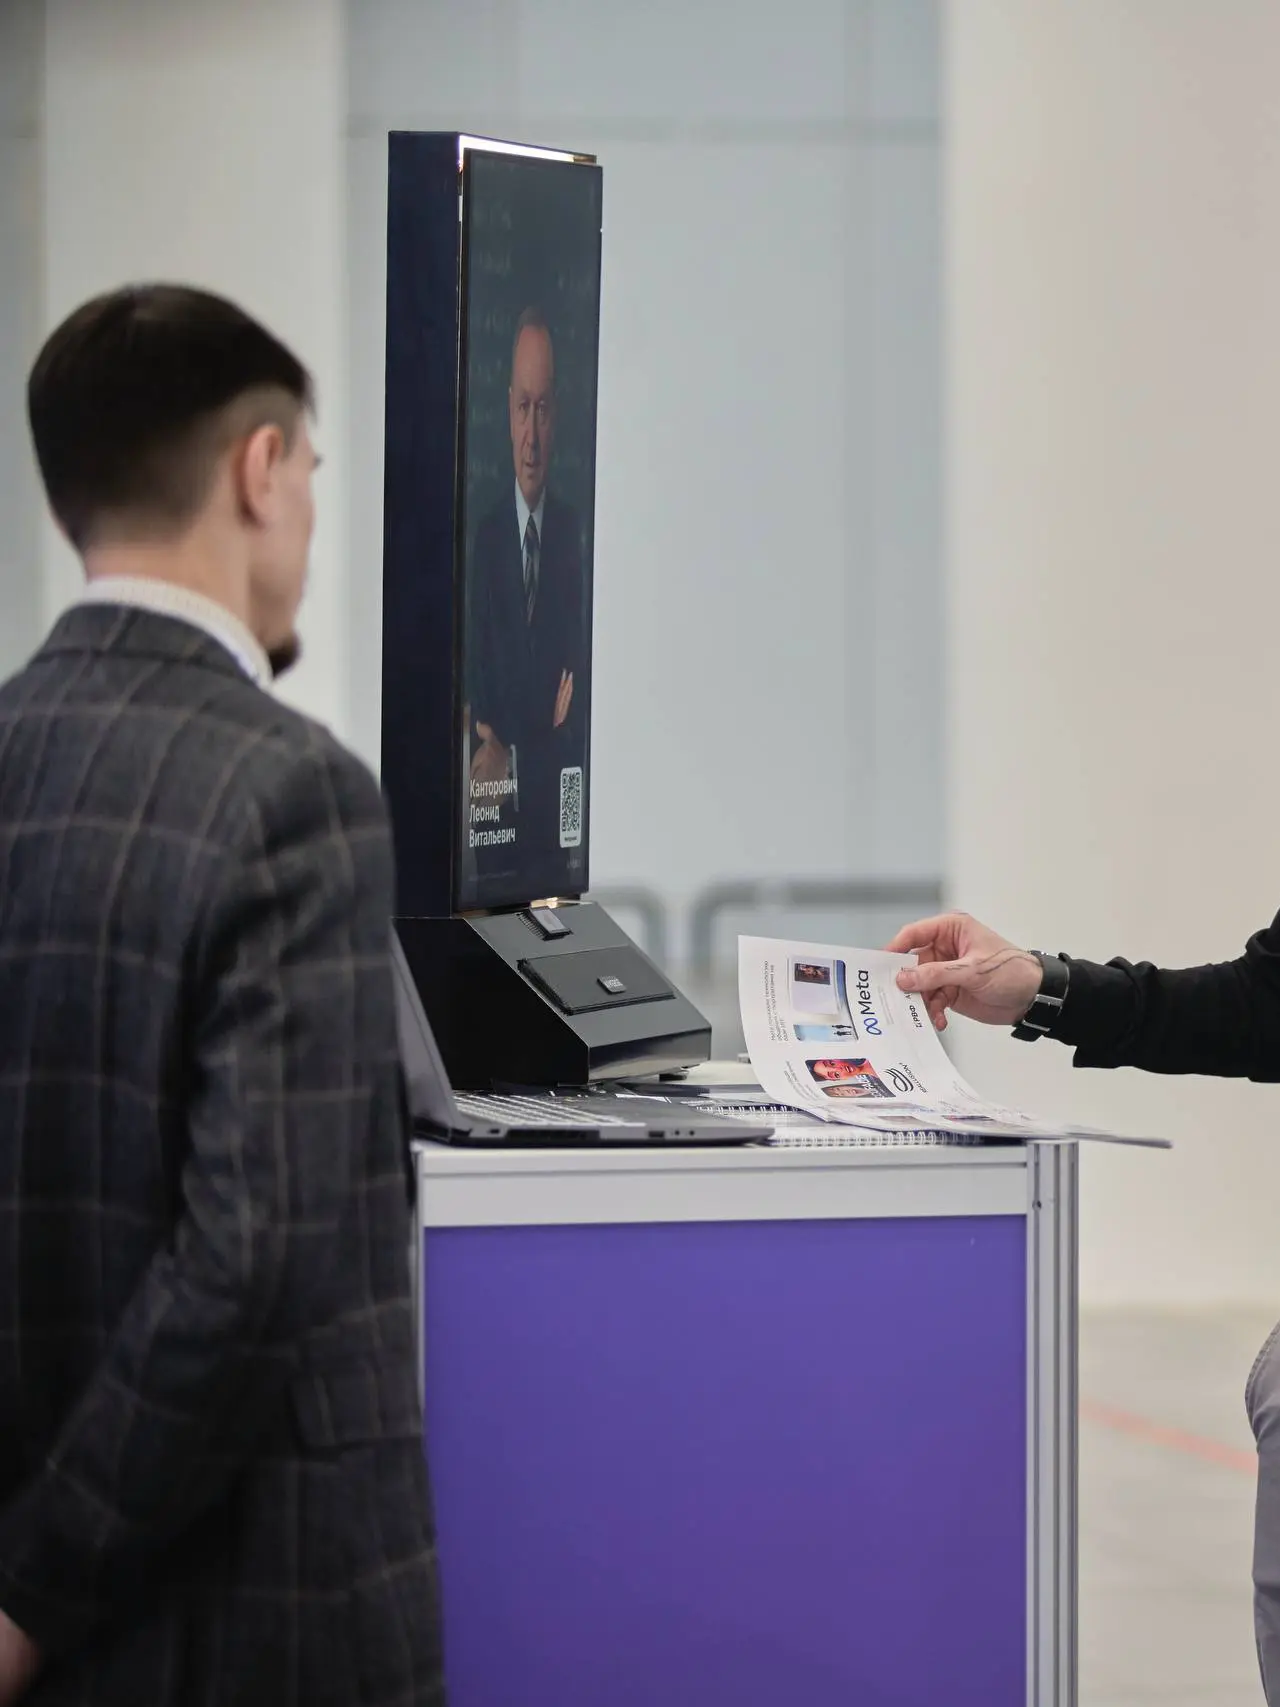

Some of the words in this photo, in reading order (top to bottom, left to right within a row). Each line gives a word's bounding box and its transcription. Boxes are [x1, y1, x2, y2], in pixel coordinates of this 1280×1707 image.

[469, 778, 518, 799] Канторович
[469, 804, 500, 823] Леонид
[469, 828, 516, 848] Витальевич
[856, 970, 873, 1015] Meta
[908, 1004, 921, 1023] РВФ
